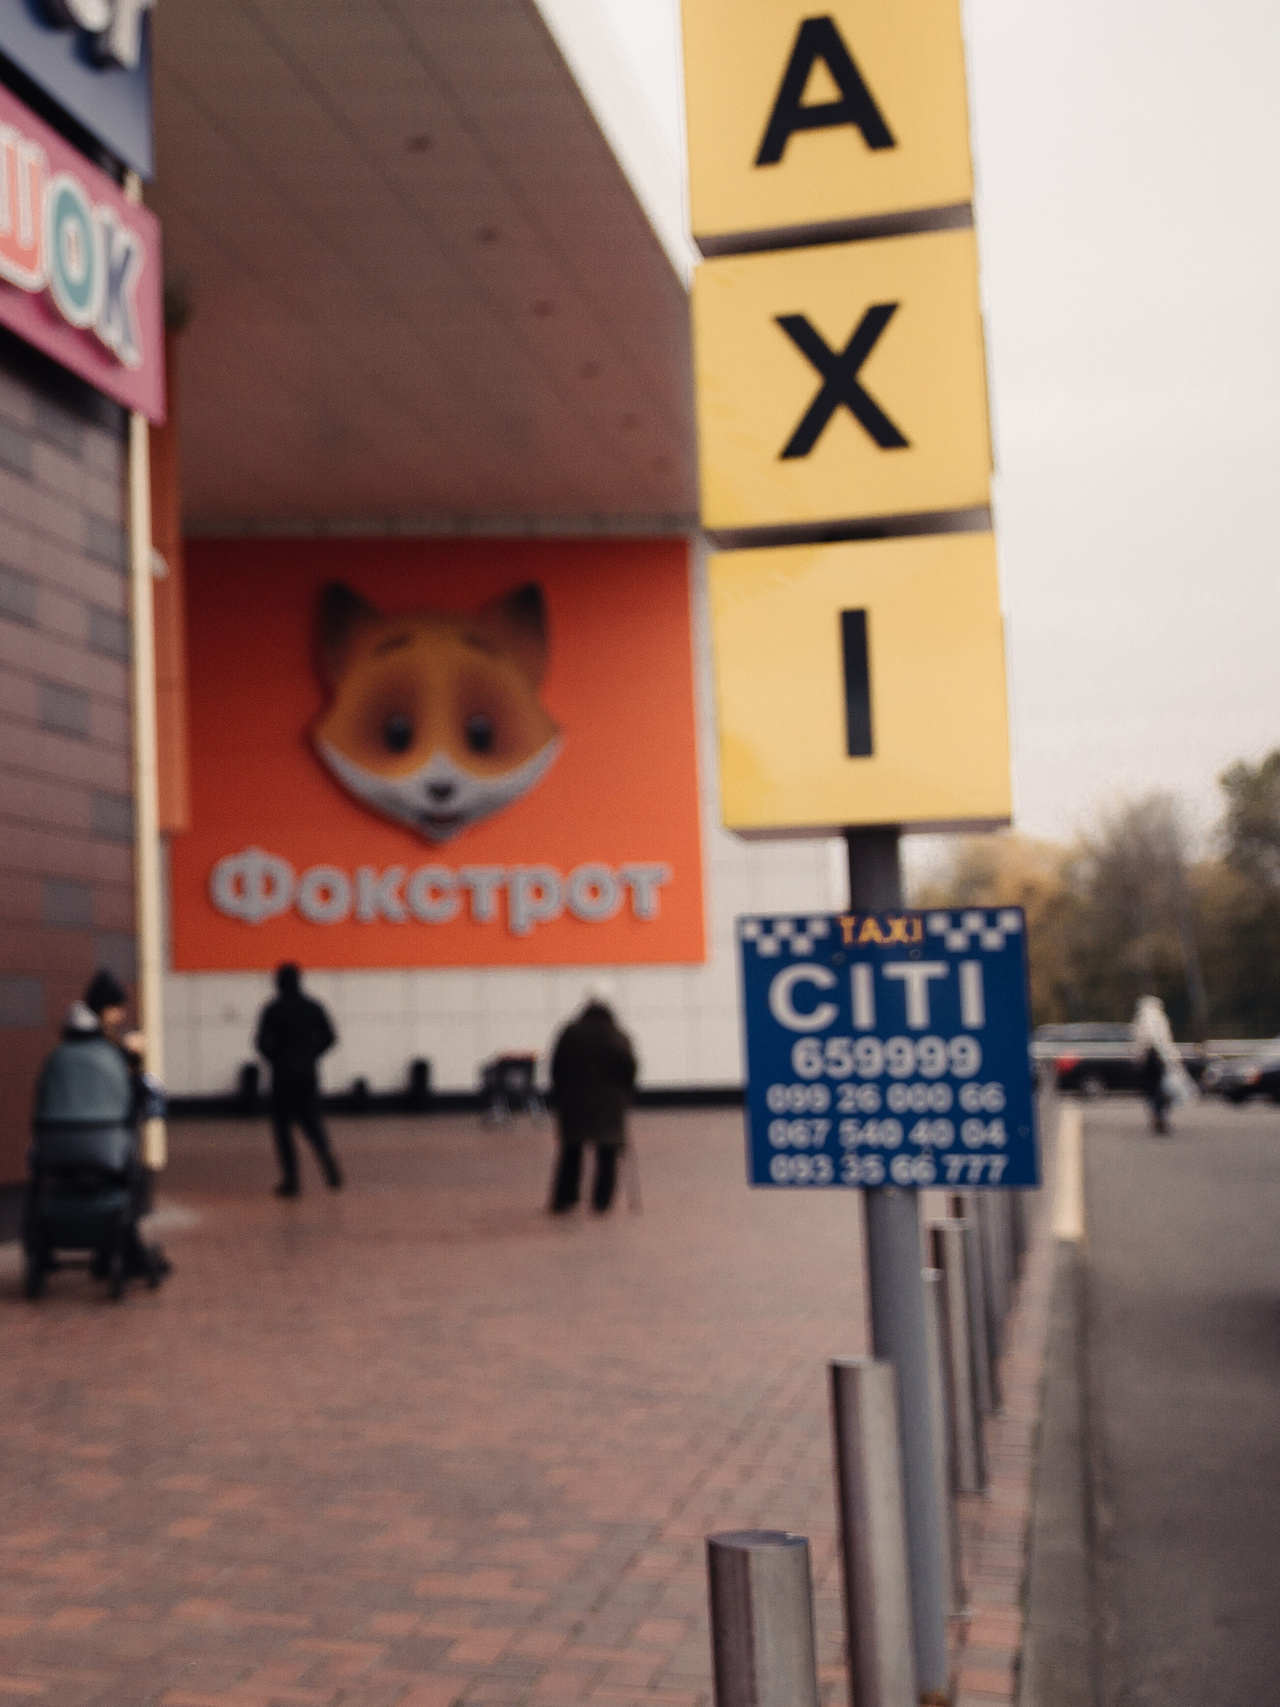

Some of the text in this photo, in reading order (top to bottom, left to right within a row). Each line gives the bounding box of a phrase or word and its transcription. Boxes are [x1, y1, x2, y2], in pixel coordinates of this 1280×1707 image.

[209, 845, 674, 938] Фокстрот
[837, 915, 925, 946] TAXI
[768, 959, 986, 1033] CITI
[791, 1035, 983, 1080] 659999
[766, 1081, 1008, 1115] 099 26 000 66
[767, 1117, 1008, 1150] 067 540 40 04
[769, 1153, 1010, 1186] 093 35 66 777
